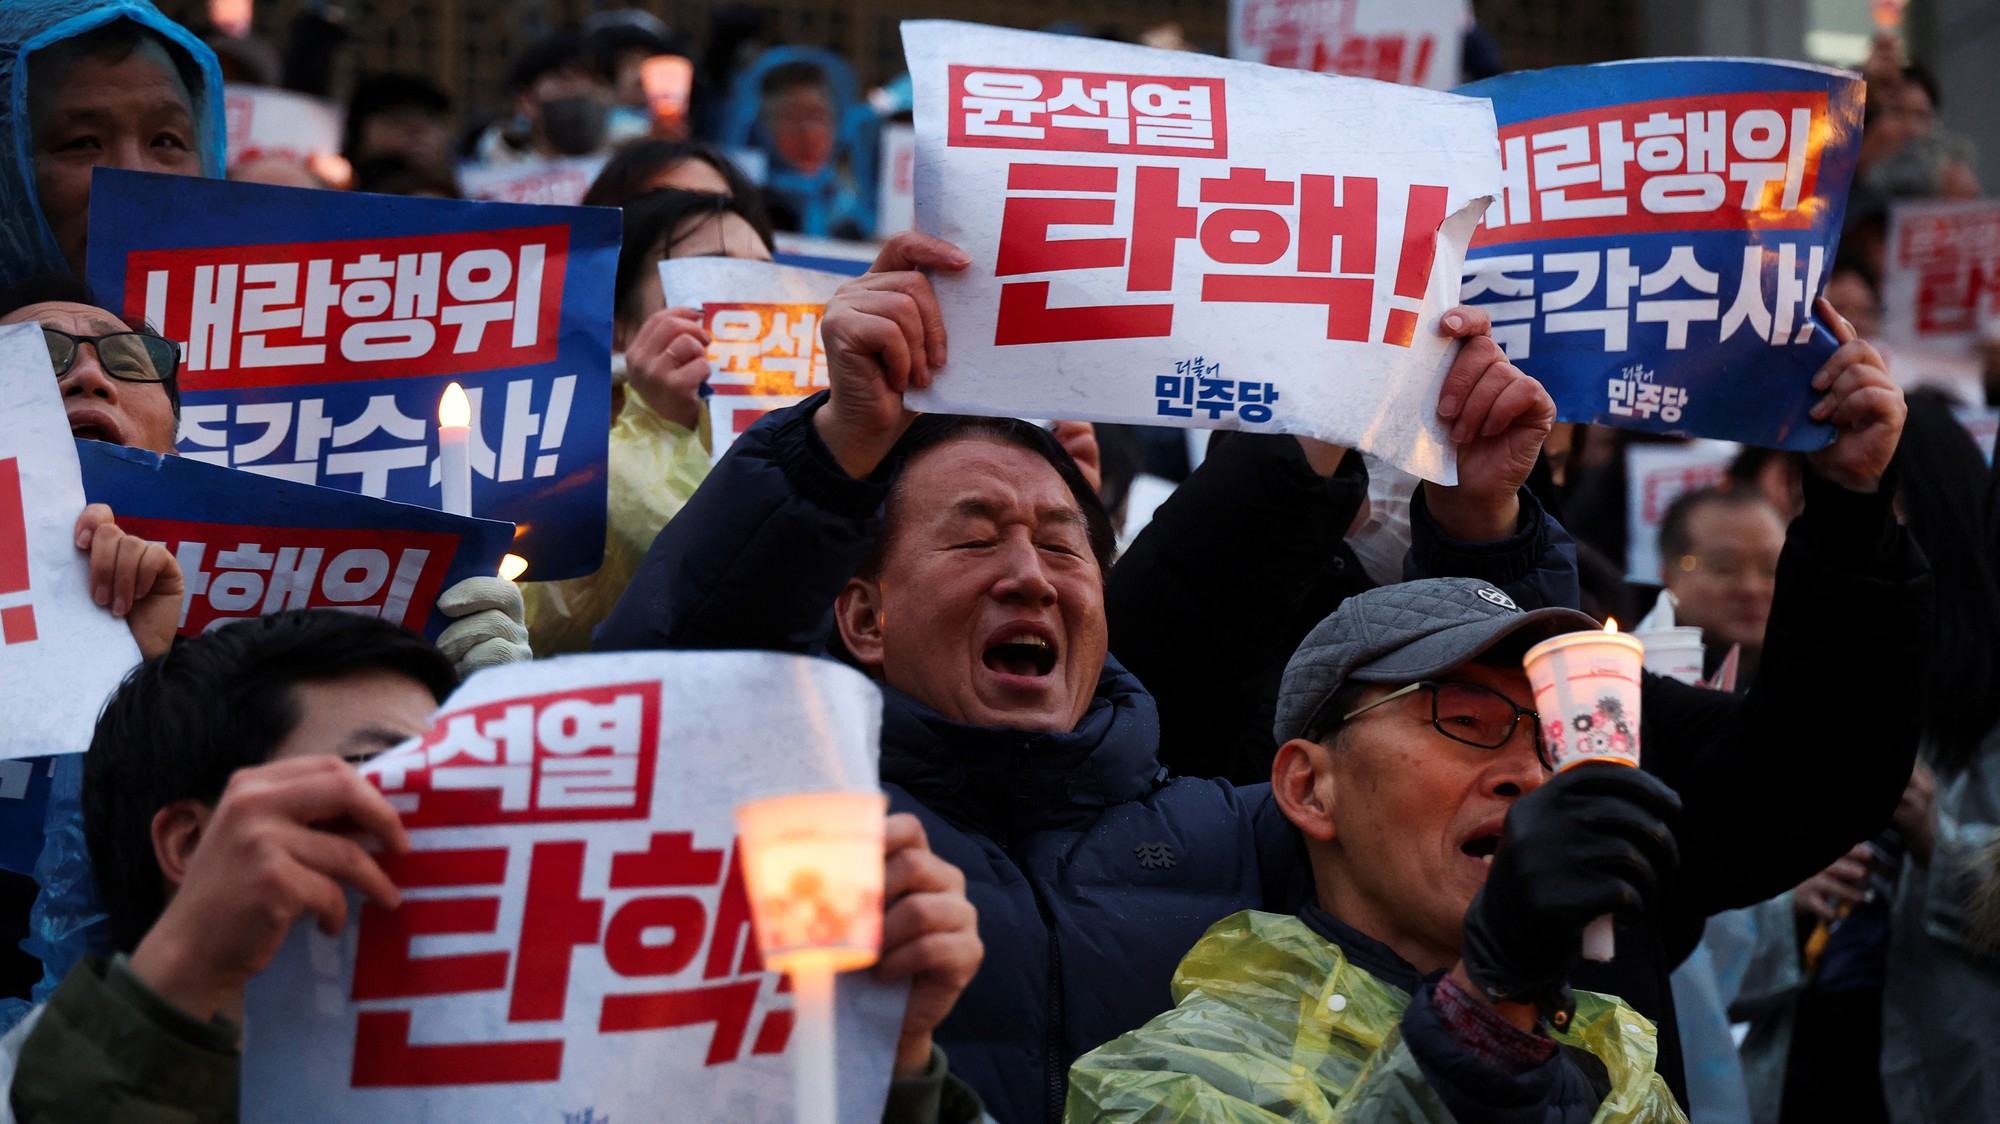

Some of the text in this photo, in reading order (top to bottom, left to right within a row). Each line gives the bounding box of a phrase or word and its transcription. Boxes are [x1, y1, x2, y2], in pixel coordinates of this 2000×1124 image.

[962, 71, 1214, 149] 윤석열
[994, 162, 1449, 348] 탄핵!
[145, 243, 547, 372] 내란행위
[1461, 243, 1824, 360] 즉각수사!
[706, 309, 831, 388] 윤석
[1174, 355, 1220, 379] 더불어
[1155, 374, 1280, 423] 민주당
[1607, 378, 1689, 424] 민주당
